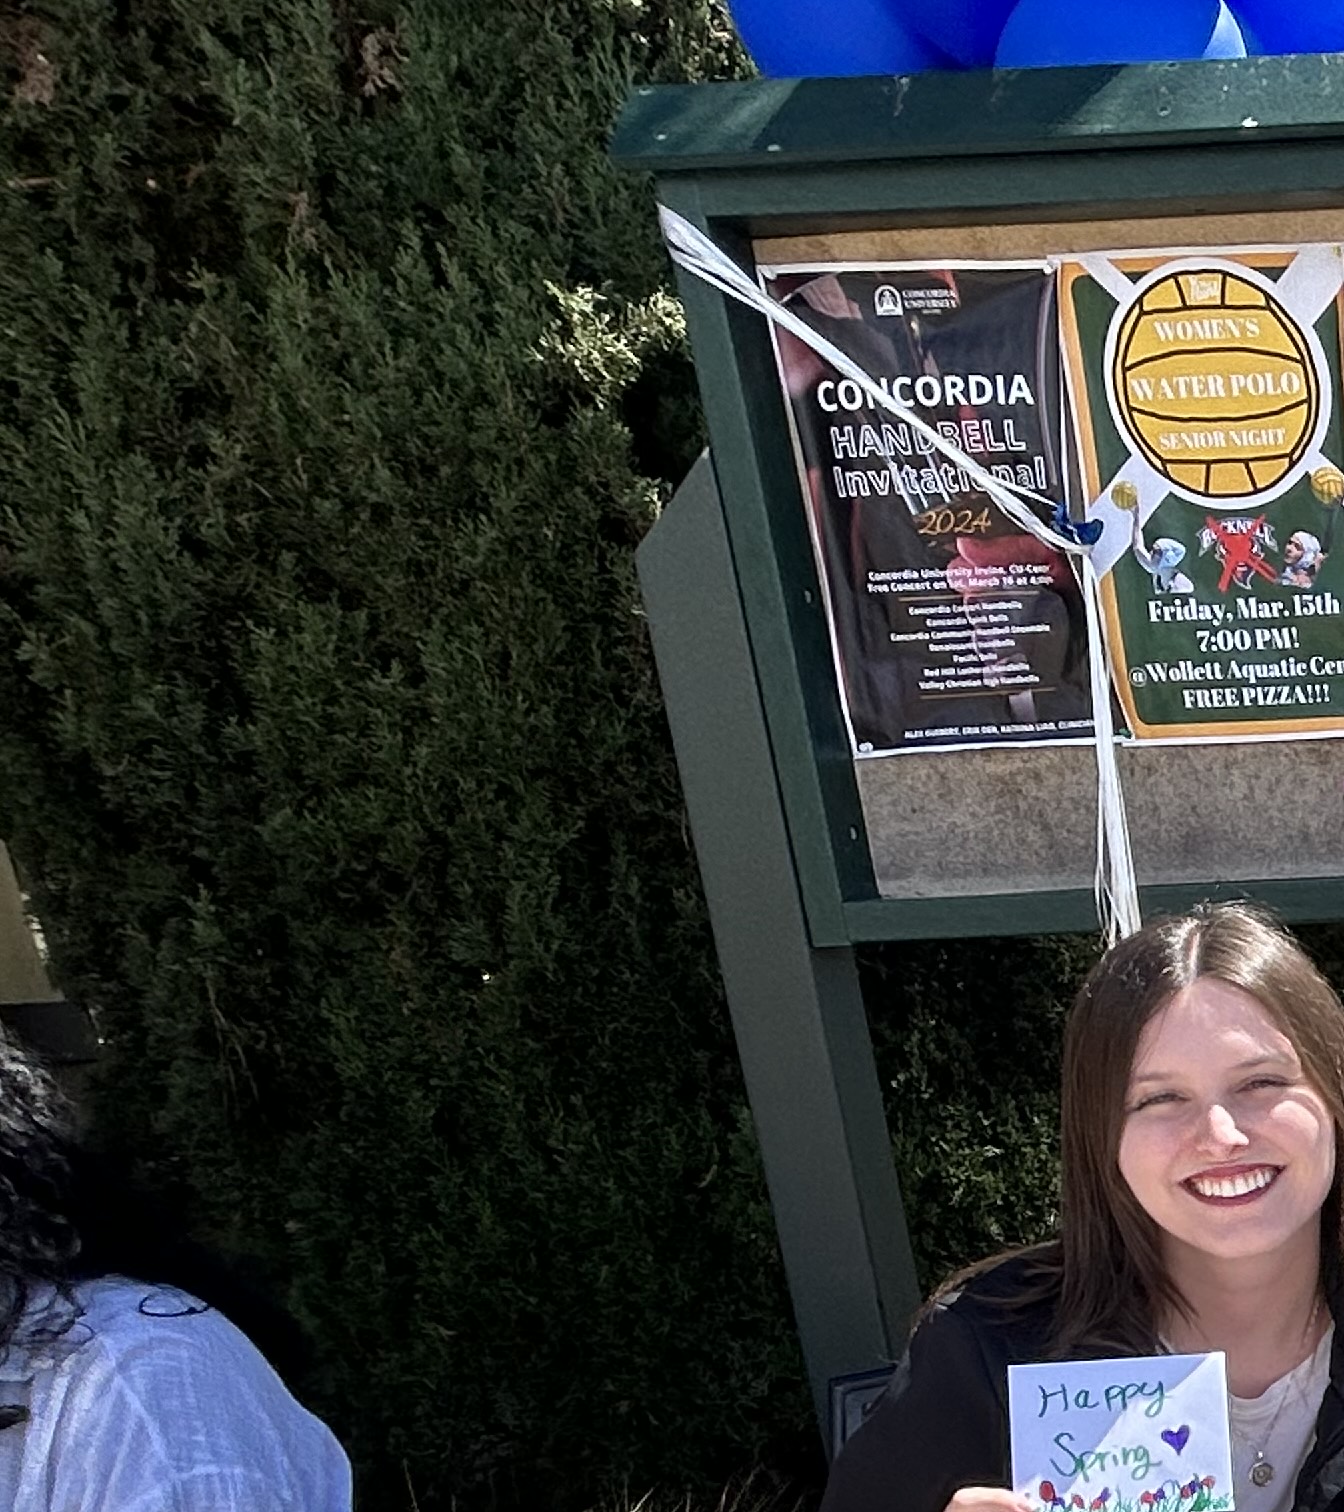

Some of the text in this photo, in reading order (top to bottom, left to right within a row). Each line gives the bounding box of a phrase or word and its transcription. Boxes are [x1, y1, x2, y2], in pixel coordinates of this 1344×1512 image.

[1154, 318, 1260, 342] WOMEN'S
[1131, 371, 1300, 401] WATER POLO
[1159, 428, 1286, 450] SENIOR NIGHT
[917, 507, 993, 535] 2024
[1148, 592, 1341, 626] Friday, Mar. 15th
[1196, 626, 1300, 652] 7:00 PM!
[1129, 660, 1223, 688] @Wollett
[1227, 657, 1307, 684] Aquatic
[1183, 684, 1331, 709] FREE PIZZA!!!
[1037, 1380, 1174, 1418] Happy
[1050, 1432, 1163, 1483] Spring
